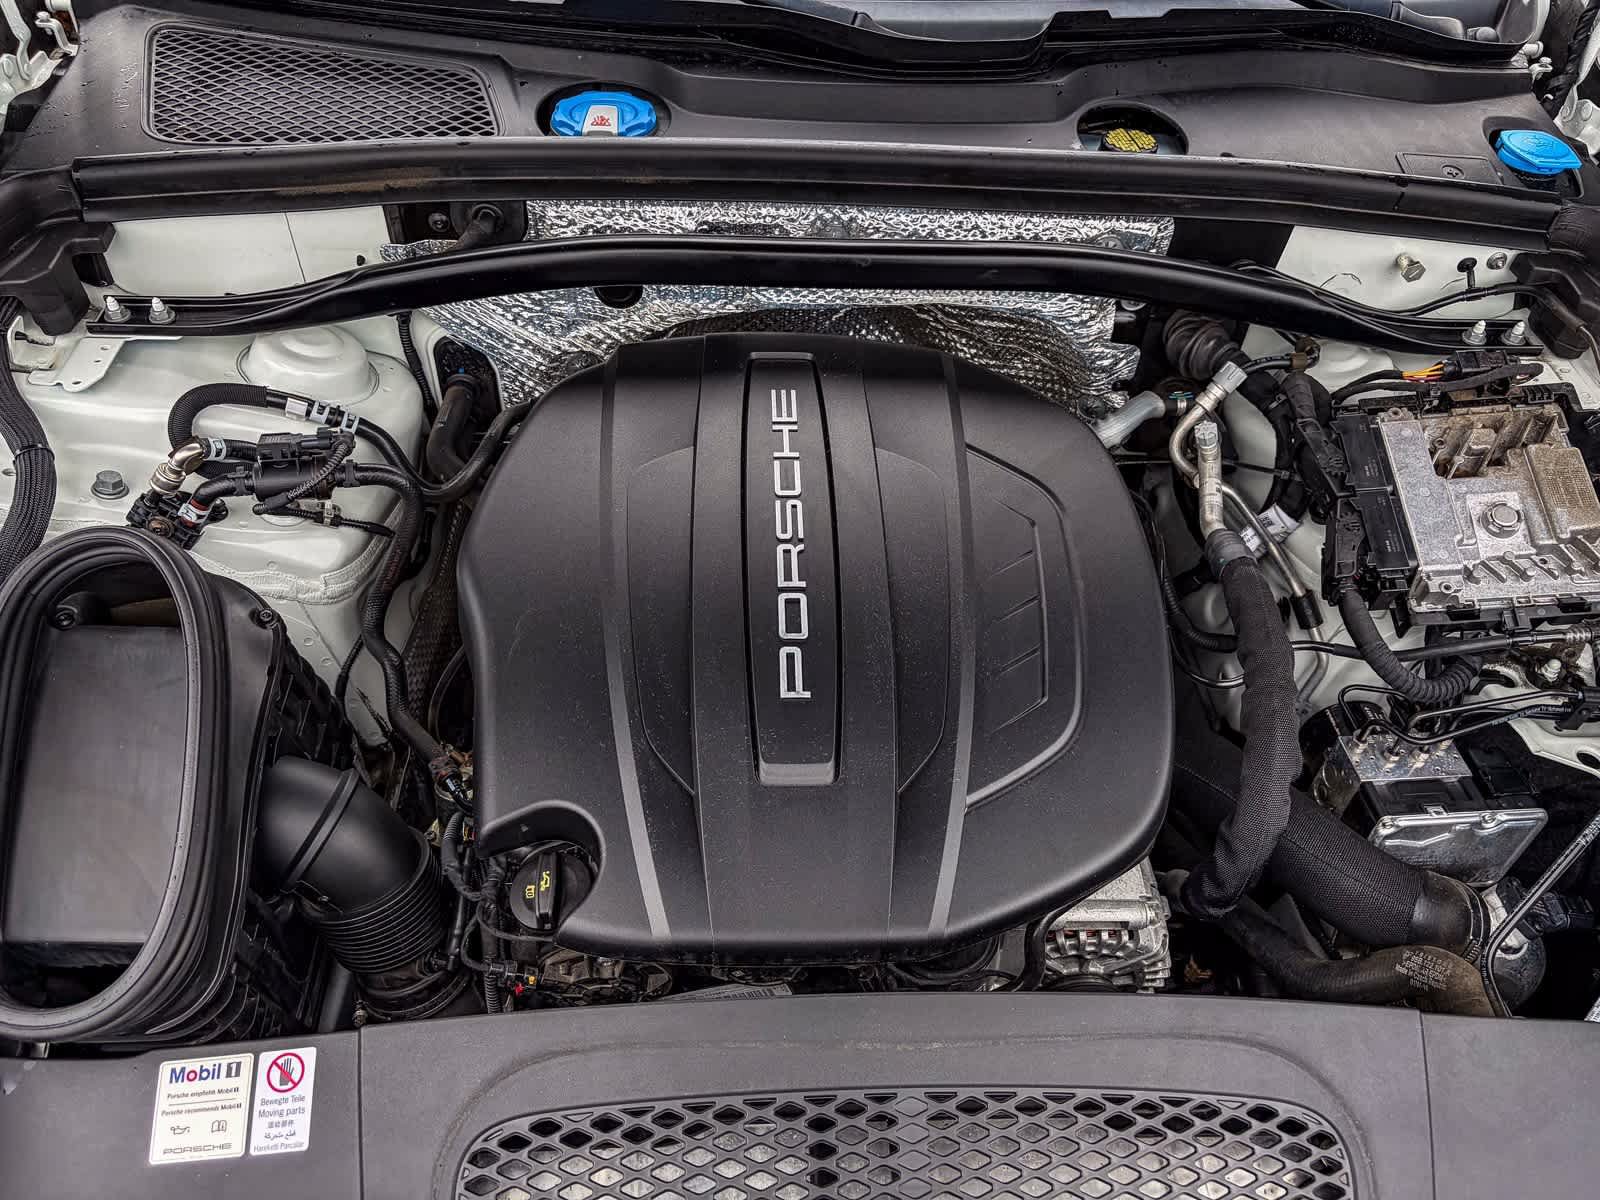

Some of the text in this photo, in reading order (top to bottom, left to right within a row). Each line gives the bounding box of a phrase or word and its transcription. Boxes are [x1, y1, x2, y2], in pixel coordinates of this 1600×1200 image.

[771, 389, 811, 698] PORSCHE
[169, 1061, 241, 1084] Mobil 1
[258, 1106, 306, 1118] Moving parts
[163, 1142, 233, 1155] PORSCHE
